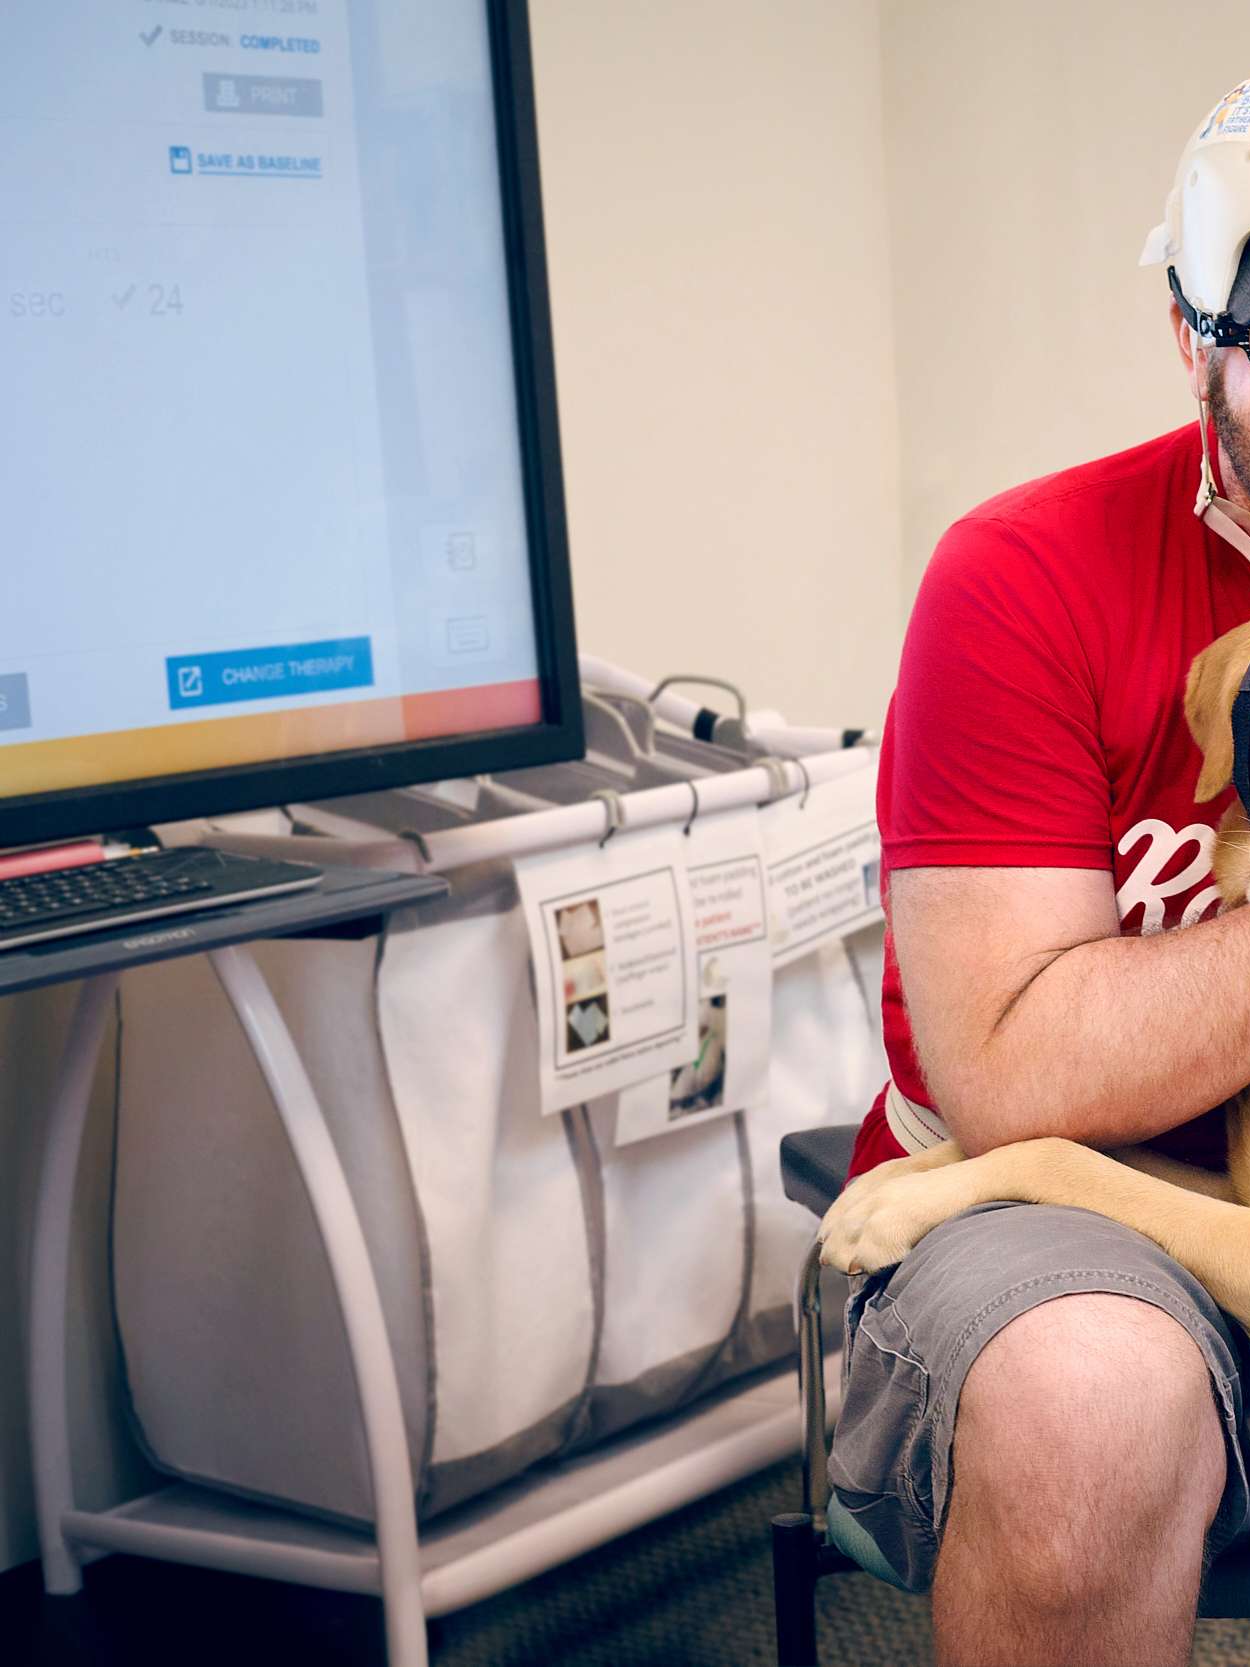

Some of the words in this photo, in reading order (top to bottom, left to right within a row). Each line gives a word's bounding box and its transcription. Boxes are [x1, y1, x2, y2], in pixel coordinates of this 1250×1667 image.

[240, 34, 321, 53] COMPLETED
[251, 86, 298, 104] PRINT
[197, 153, 233, 168] SAVE
[236, 155, 255, 169] AS
[258, 155, 321, 171] BASELINE
[10, 291, 65, 317] sec
[149, 283, 184, 316] 24
[222, 662, 284, 685] CHANGE
[288, 655, 355, 678] THERAPY
